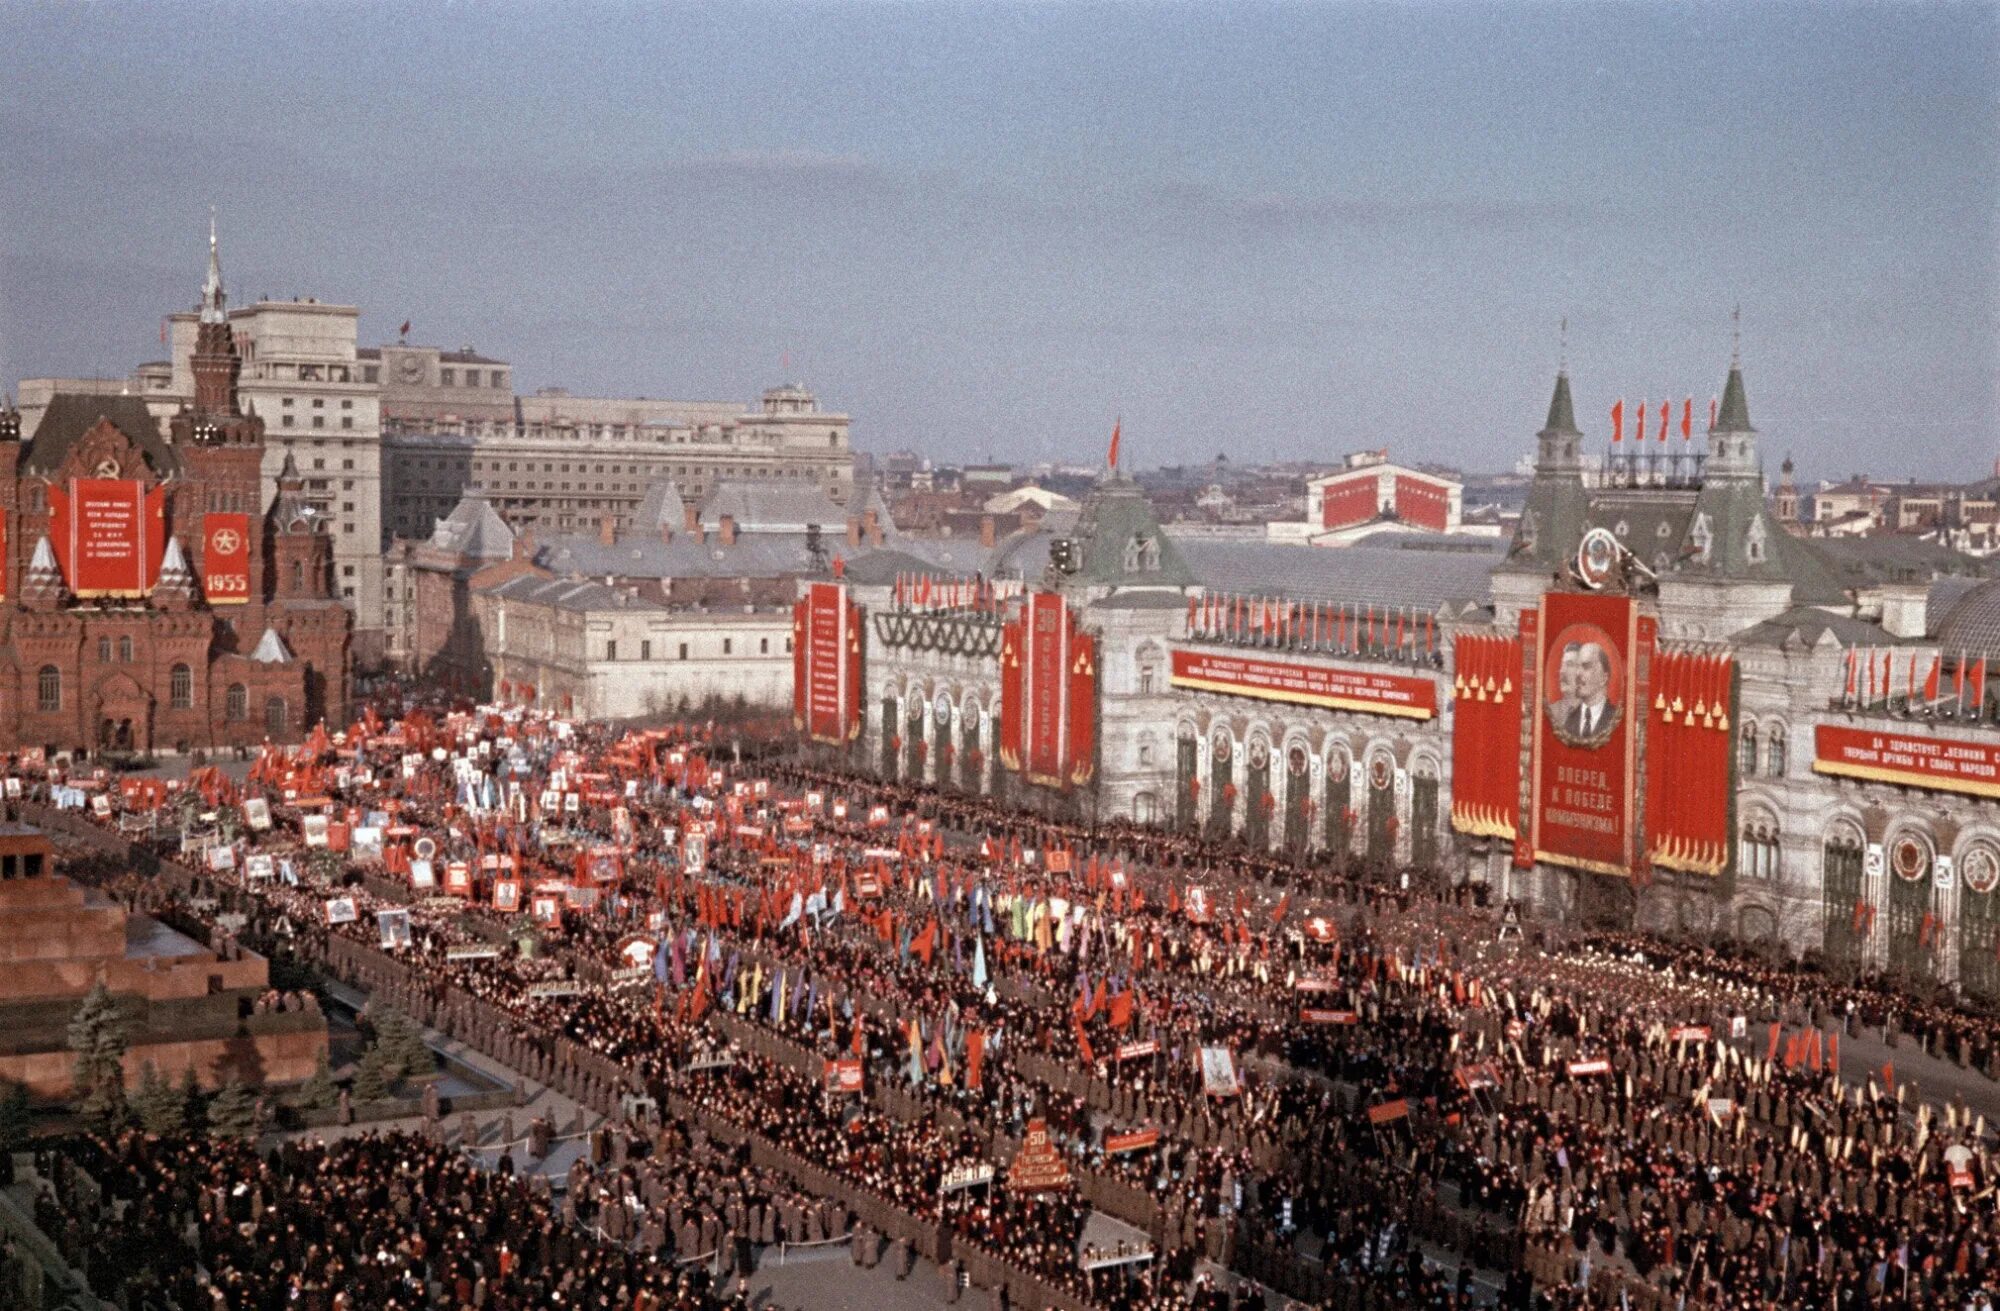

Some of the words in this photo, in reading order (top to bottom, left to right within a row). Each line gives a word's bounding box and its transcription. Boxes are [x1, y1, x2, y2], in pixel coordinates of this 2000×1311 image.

[207, 574, 248, 592] 1955
[1890, 740, 1941, 756] ЗДРАВСТВУЕТ
[1565, 788, 1614, 811] ПОБЕДЕ
[1029, 1131, 1046, 1146] 50
